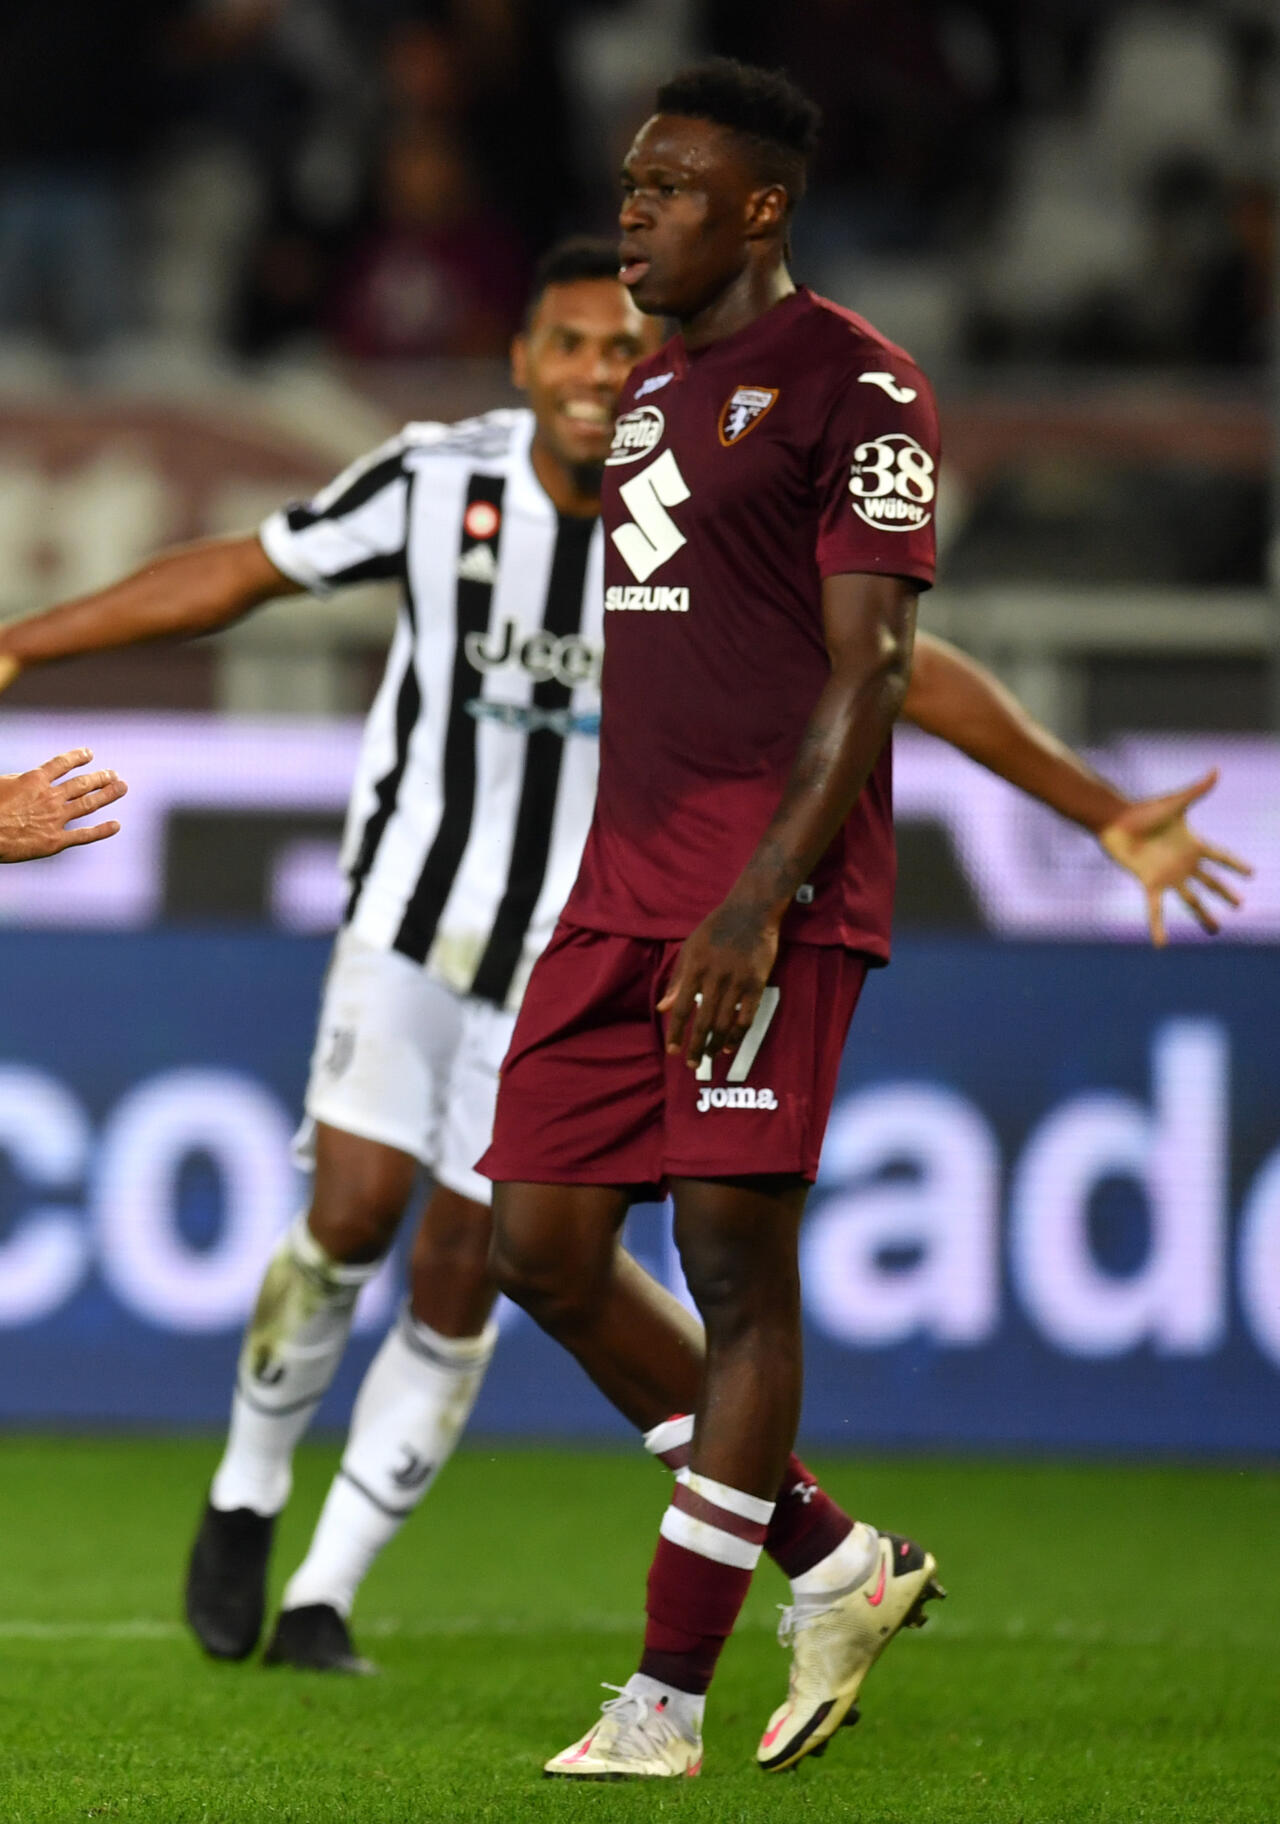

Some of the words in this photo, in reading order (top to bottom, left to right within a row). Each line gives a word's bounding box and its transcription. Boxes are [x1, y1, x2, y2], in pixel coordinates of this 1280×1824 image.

[848, 442, 935, 503] 38
[605, 585, 690, 612] SUZUKI
[464, 618, 604, 690] Jee
